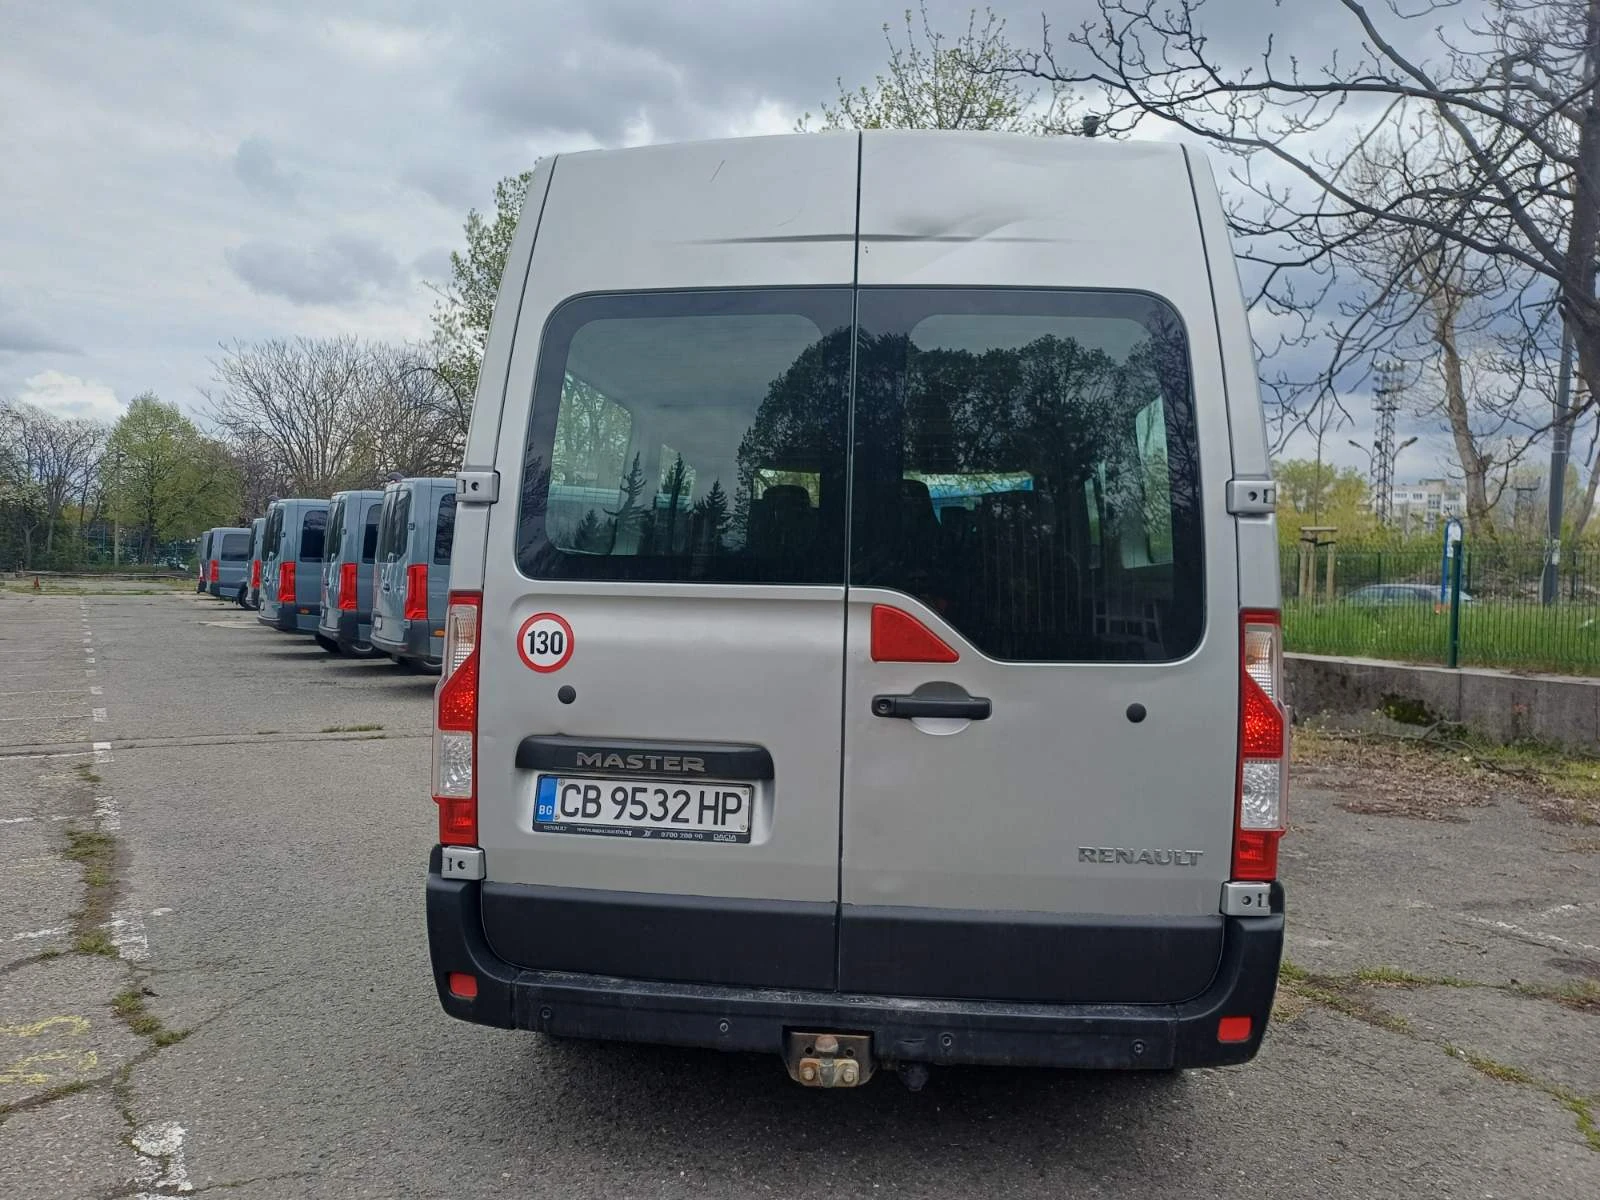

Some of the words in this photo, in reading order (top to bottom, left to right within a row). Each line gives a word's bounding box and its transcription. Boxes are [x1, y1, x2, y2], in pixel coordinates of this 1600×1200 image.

[528, 631, 563, 655] 130
[576, 752, 705, 772] MASTER
[538, 805, 553, 815] BG
[560, 783, 602, 818] CB
[610, 785, 692, 823] 9532
[697, 790, 742, 826] HP
[1078, 846, 1204, 866] RENAULT
